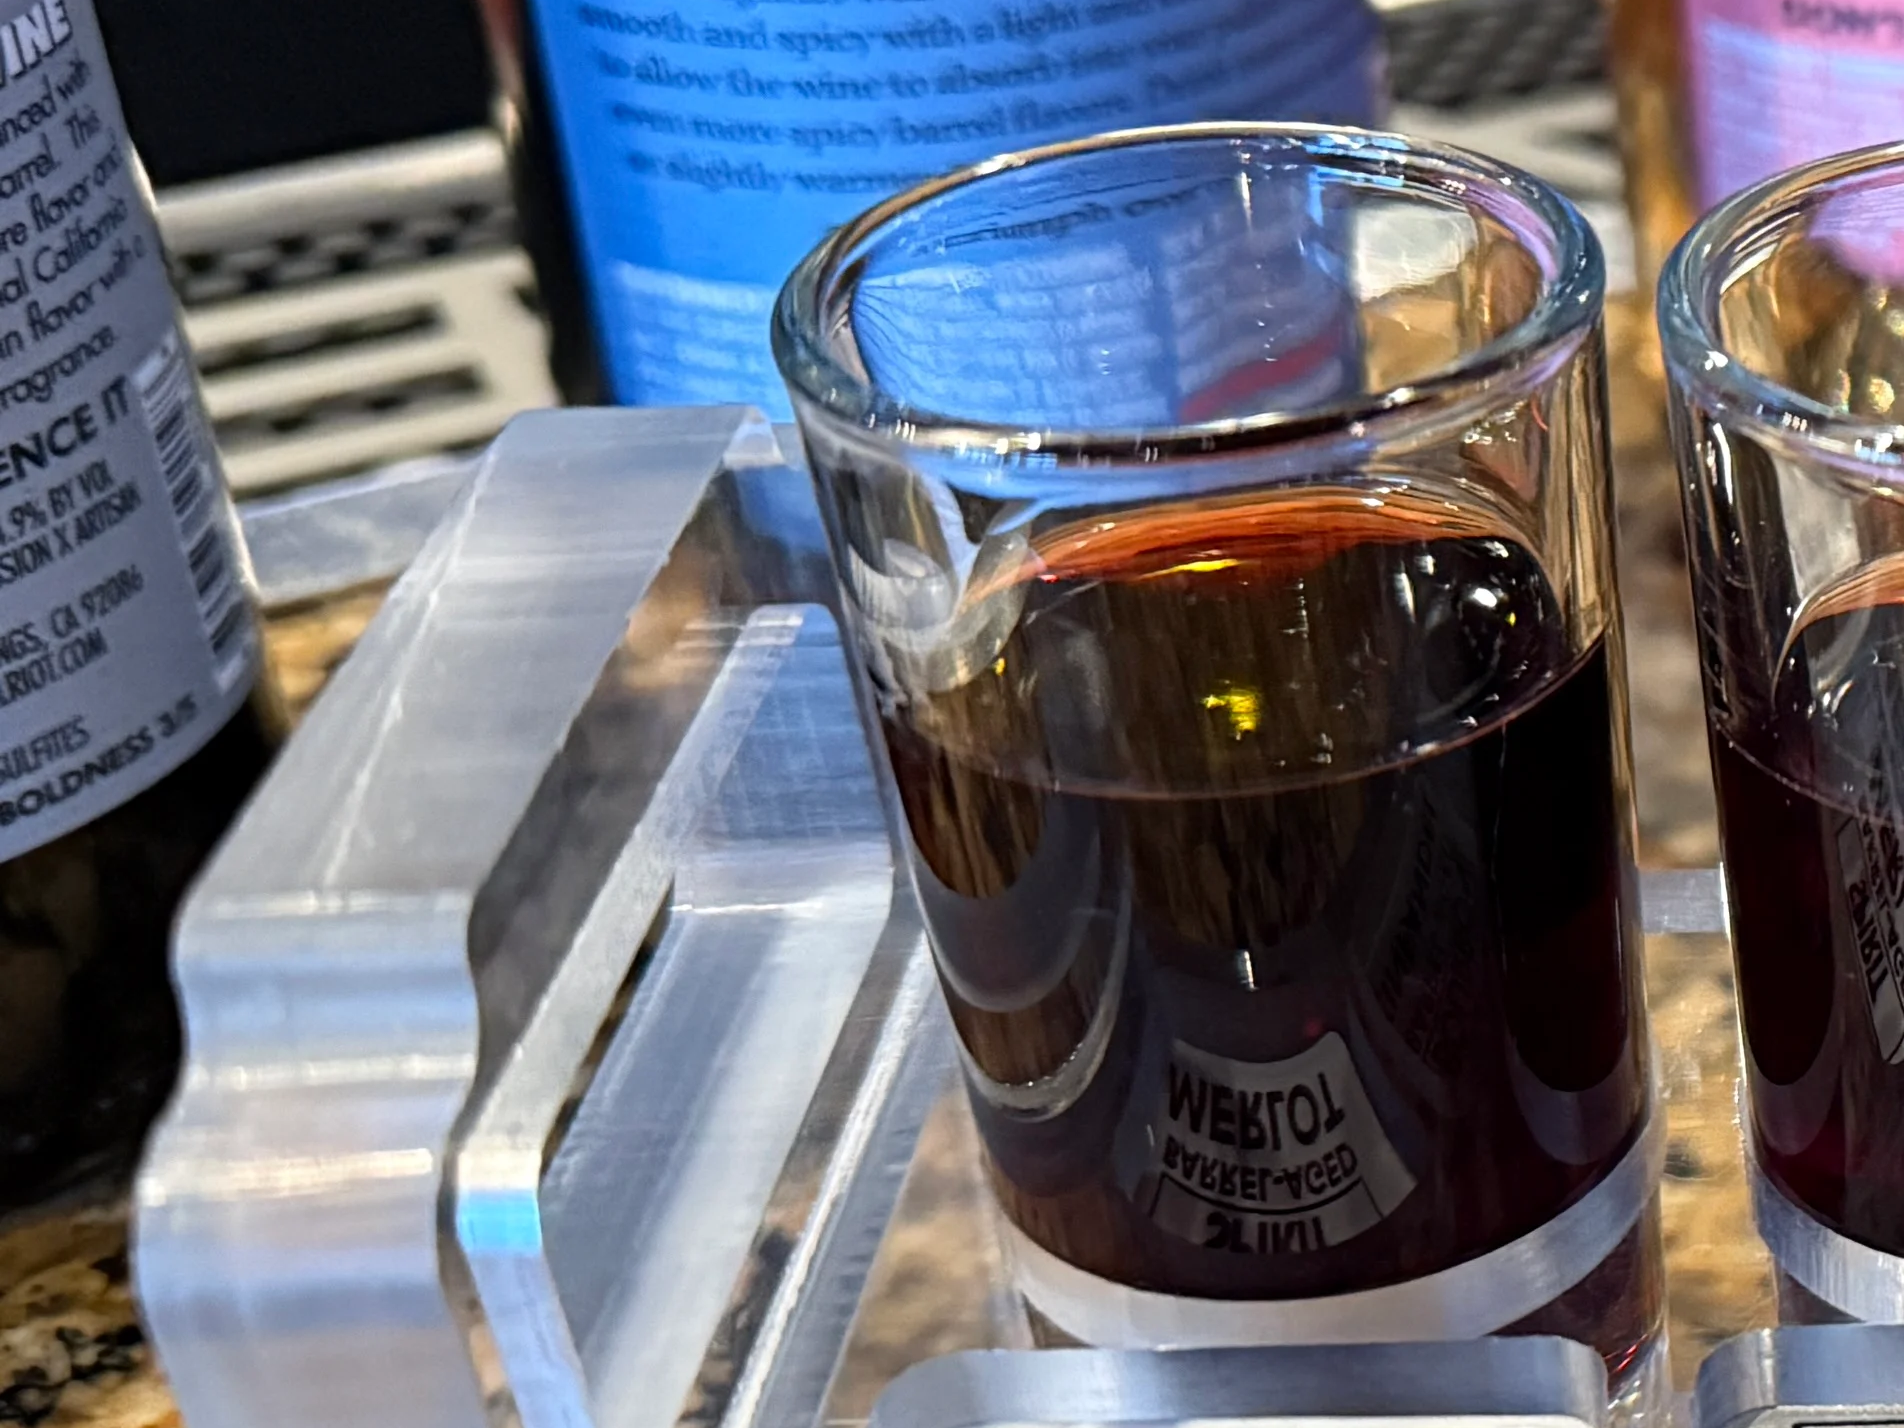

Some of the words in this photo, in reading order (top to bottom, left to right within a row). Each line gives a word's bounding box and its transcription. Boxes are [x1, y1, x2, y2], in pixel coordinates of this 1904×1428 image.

[58, 47, 90, 102] with
[64, 104, 103, 149] This
[28, 174, 90, 235] flavor
[33, 194, 129, 284] California
[25, 278, 95, 343] flavor
[101, 373, 130, 427] IT
[48, 476, 76, 521] BY
[53, 523, 75, 559] X
[74, 477, 143, 548] ARTISAN
[50, 603, 81, 640] CA
